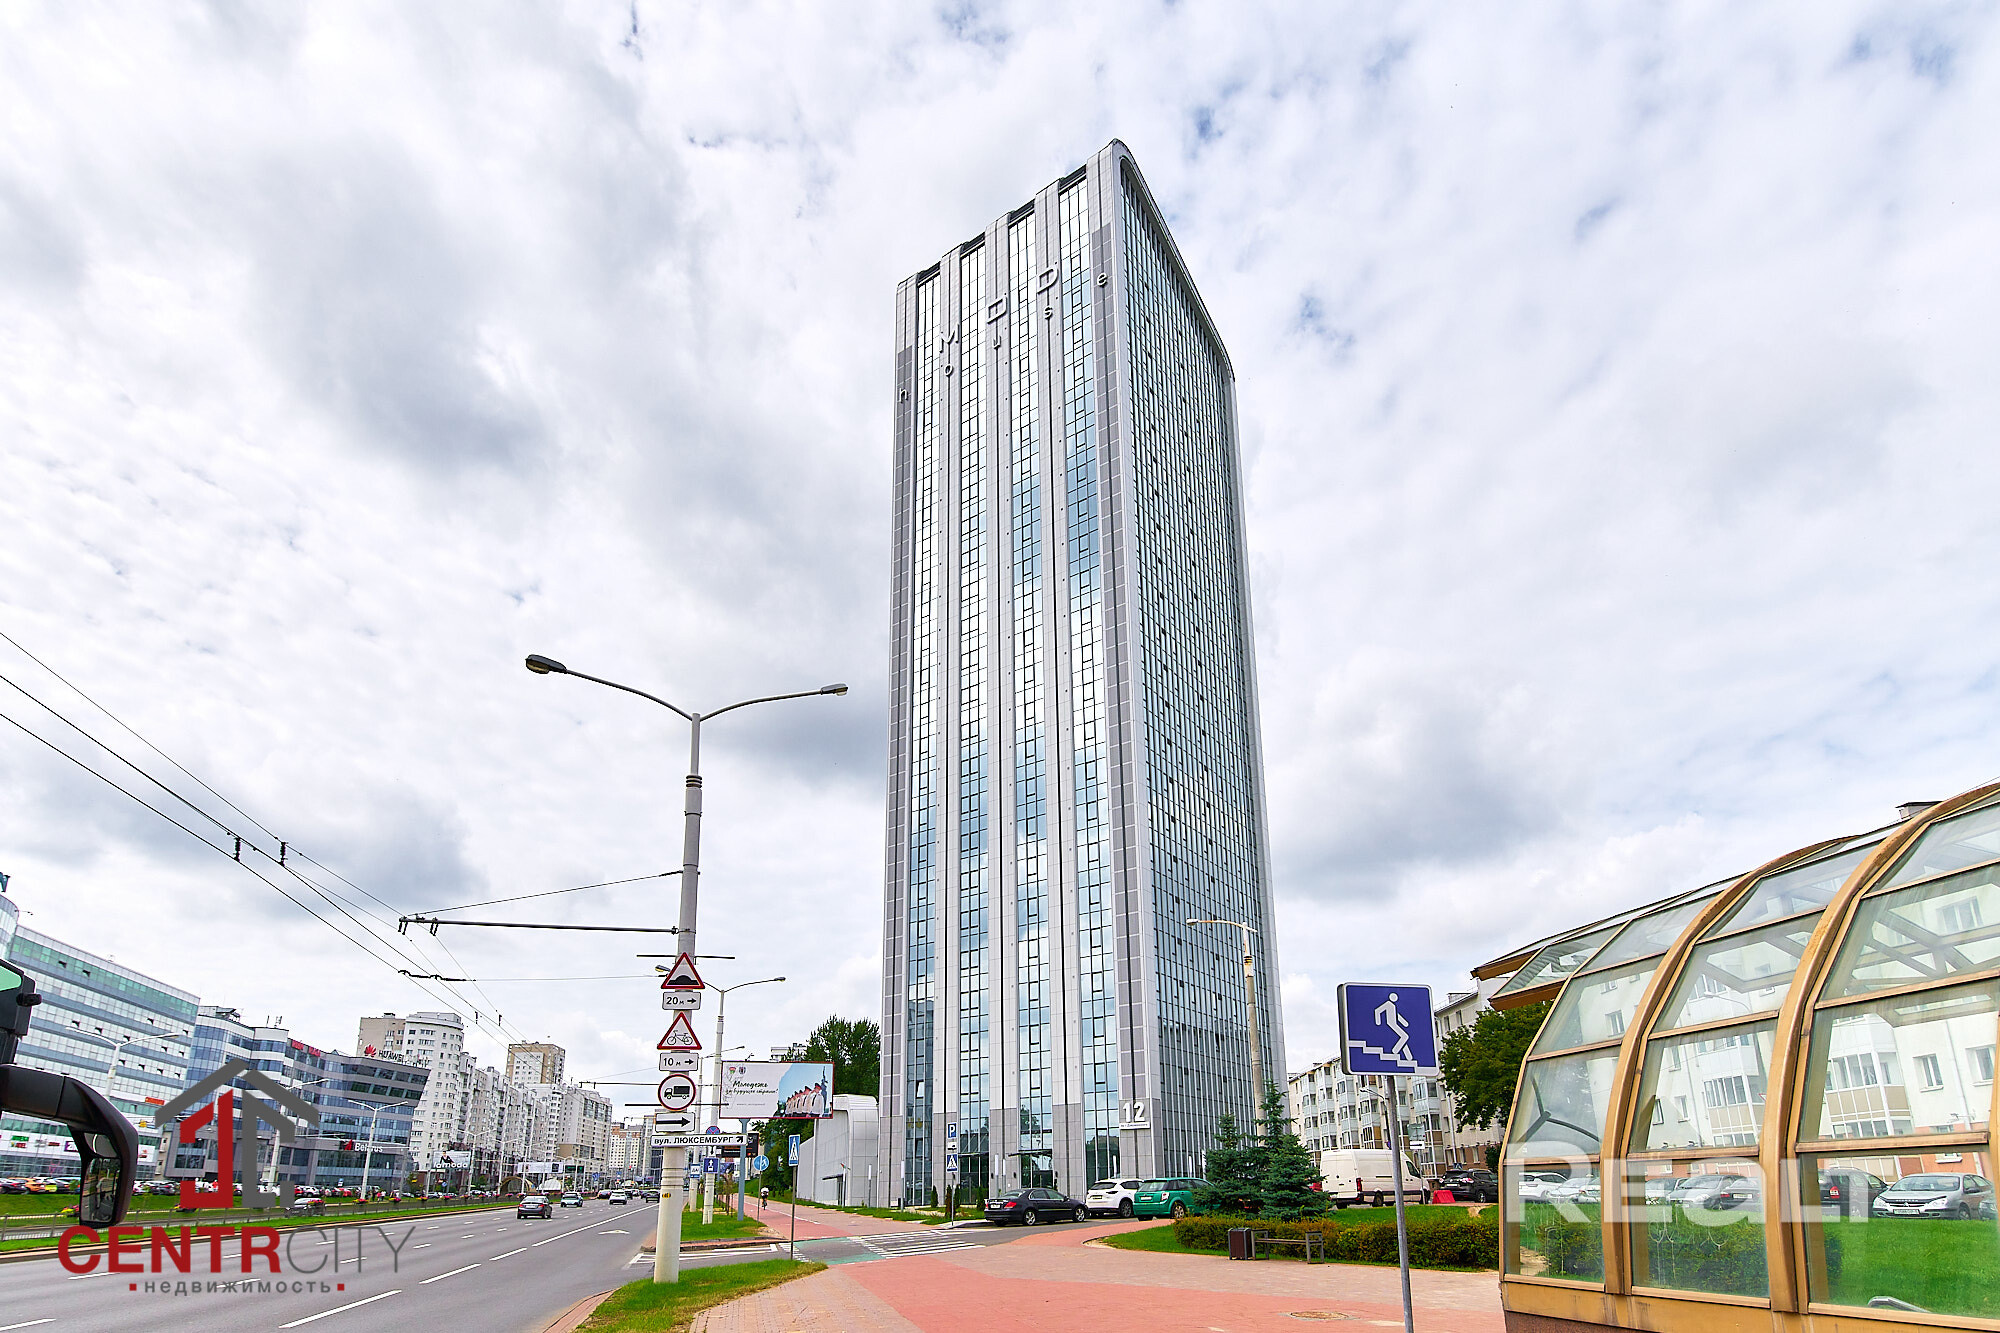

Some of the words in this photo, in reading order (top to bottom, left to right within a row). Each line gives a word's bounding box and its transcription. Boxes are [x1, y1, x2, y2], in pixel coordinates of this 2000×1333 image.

[666, 996, 678, 1005] 20
[378, 1050, 405, 1063] HUAWEI
[663, 1057, 674, 1066] 10
[1122, 1101, 1146, 1122] 12
[654, 1137, 671, 1145] вул.
[673, 1136, 734, 1144] ЛЮКСЕМБУРГ
